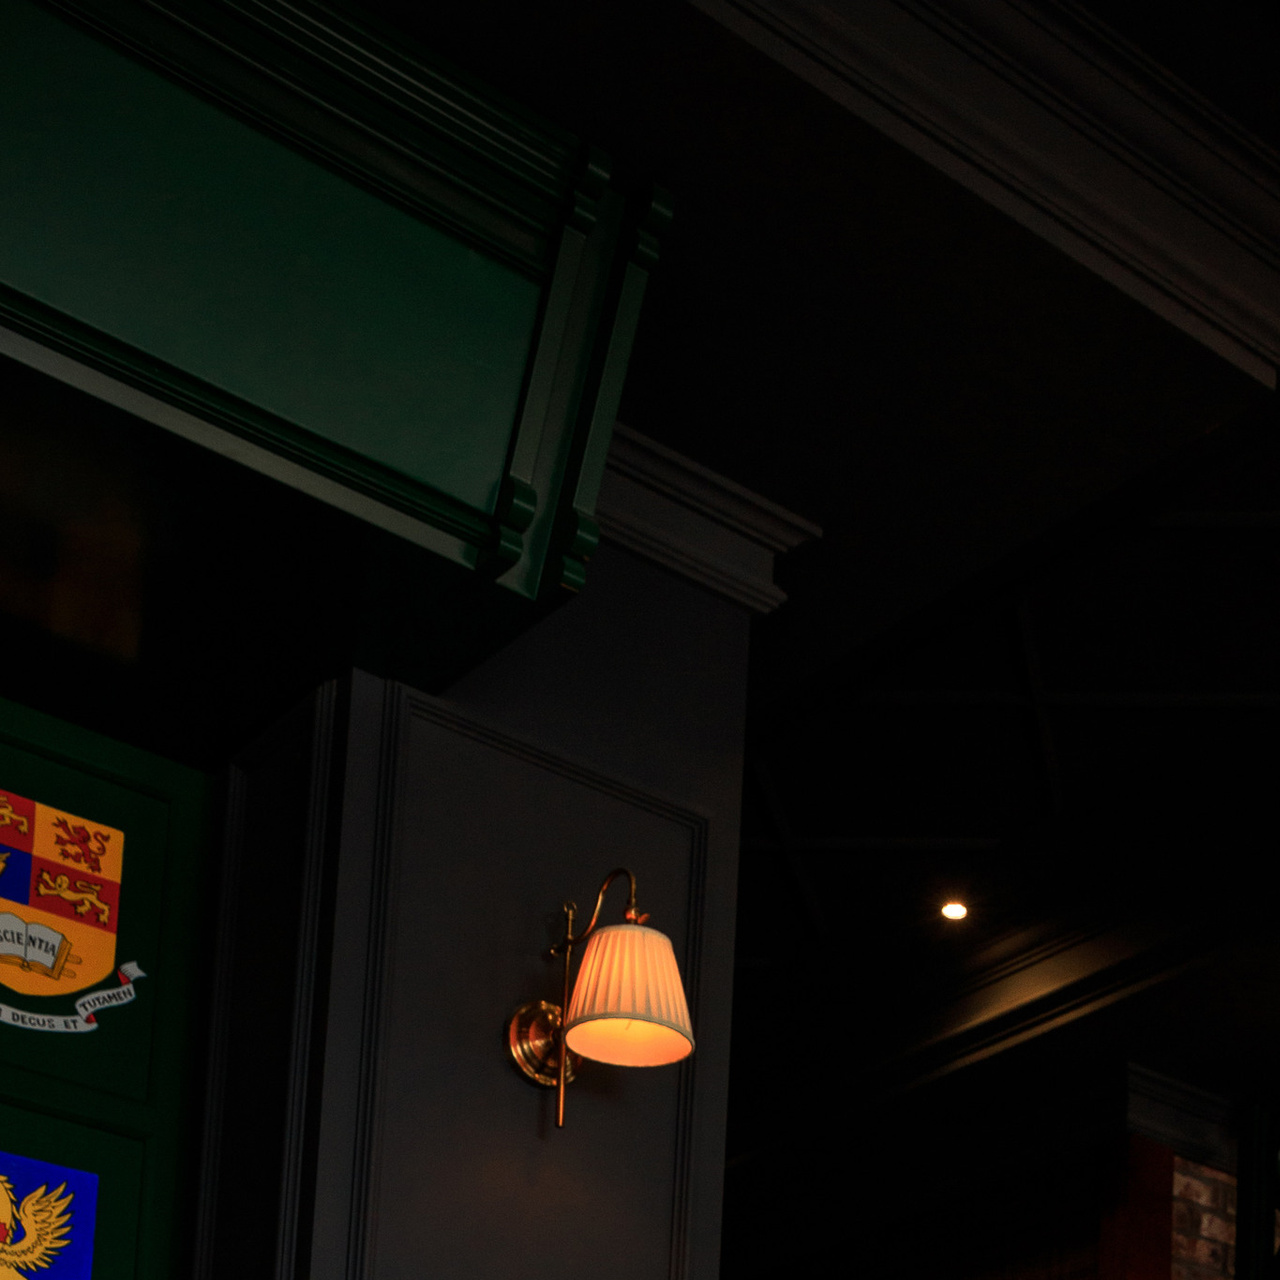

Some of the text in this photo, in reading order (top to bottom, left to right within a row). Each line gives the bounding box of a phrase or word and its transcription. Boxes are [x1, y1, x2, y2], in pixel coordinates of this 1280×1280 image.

[11, 1011, 56, 1030] DECUS
[62, 1019, 79, 1030] ET
[80, 987, 133, 1013] TUTAMEN
